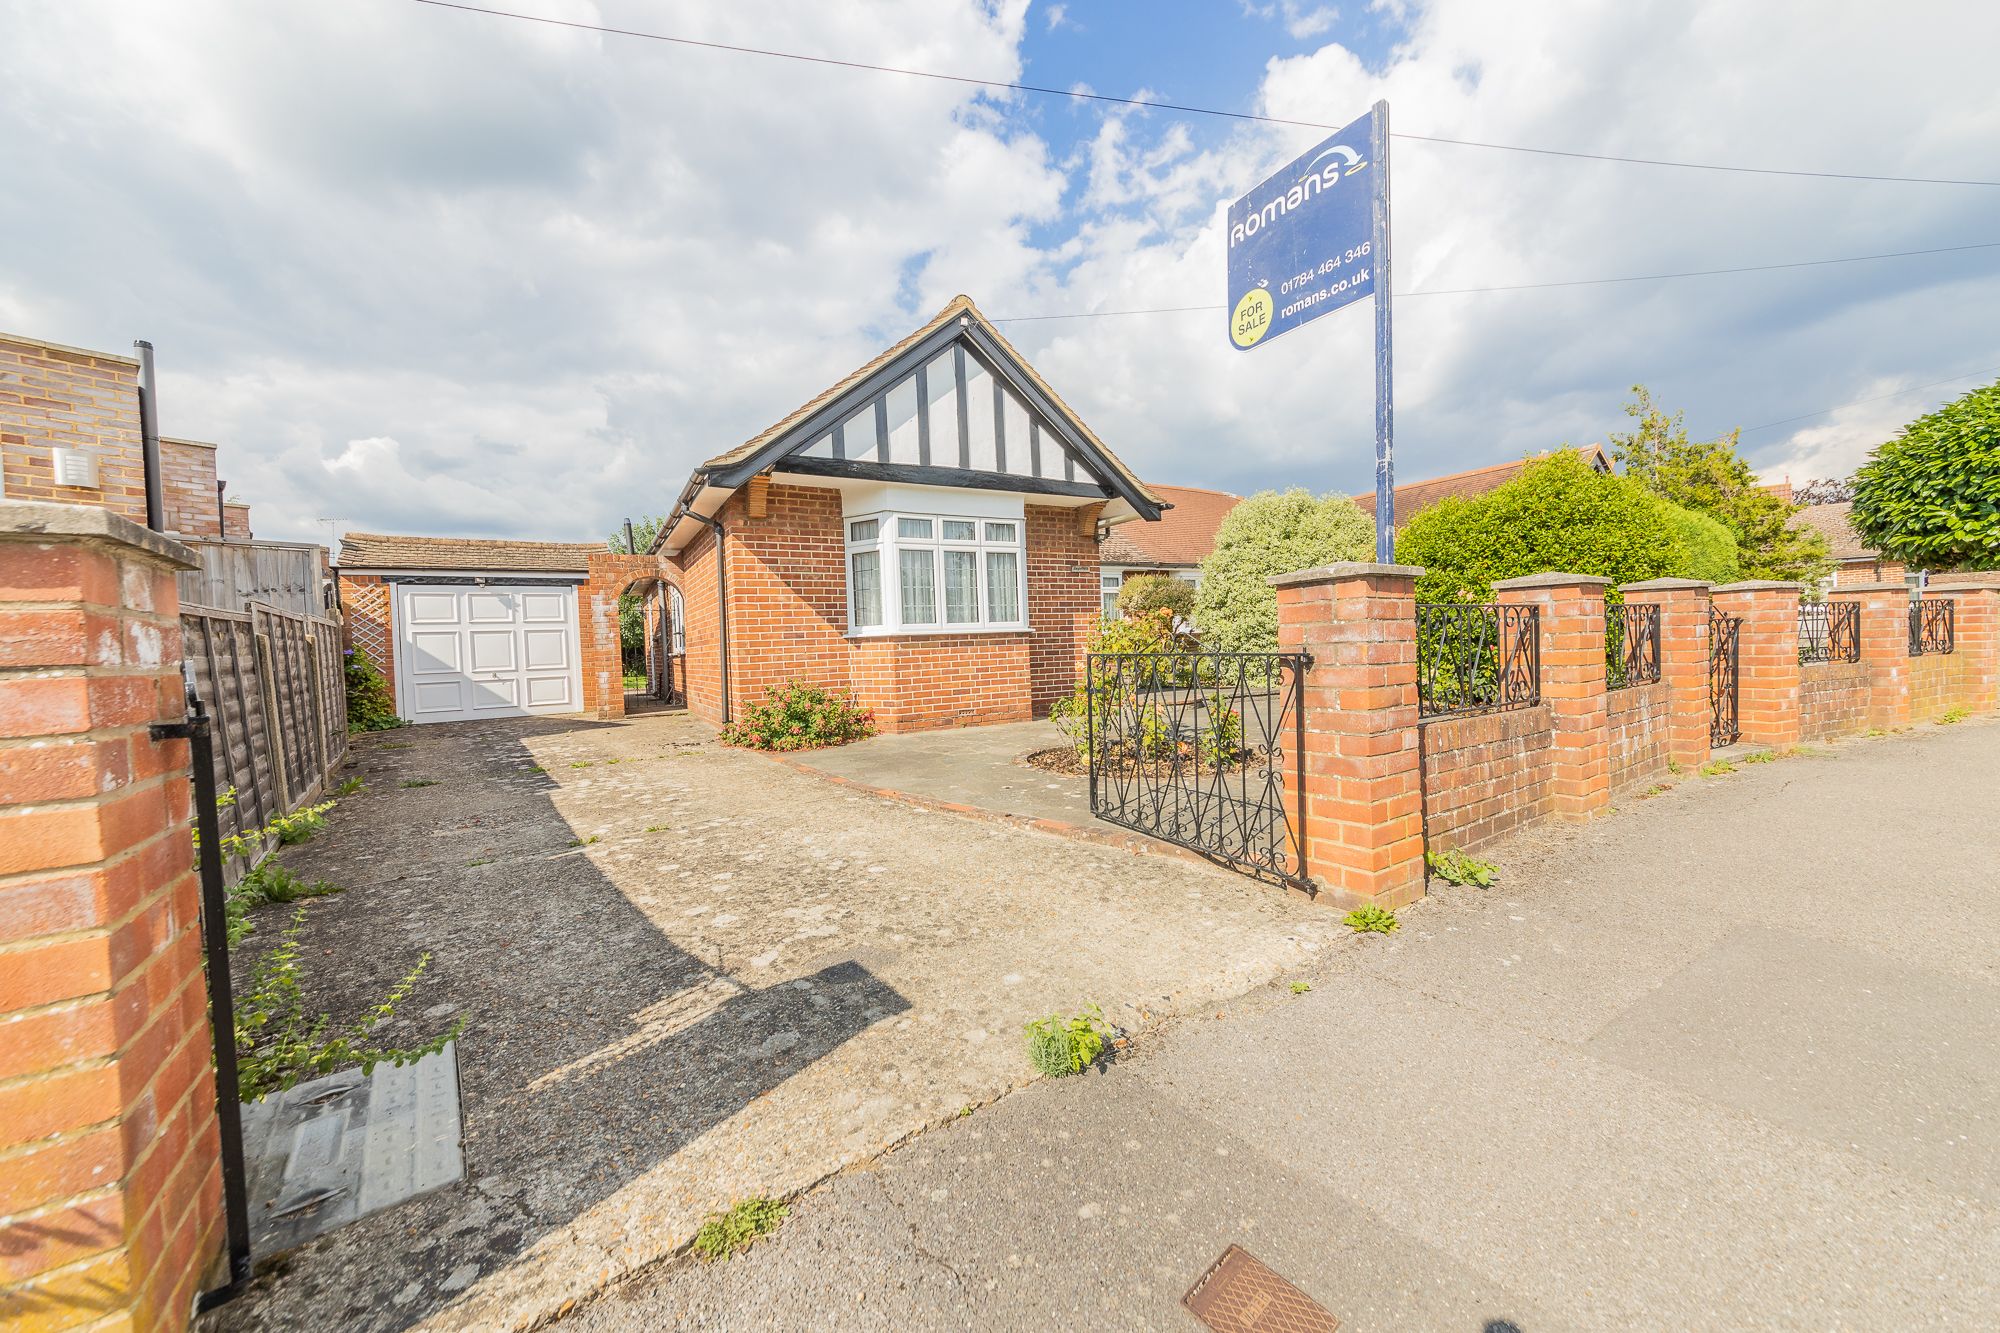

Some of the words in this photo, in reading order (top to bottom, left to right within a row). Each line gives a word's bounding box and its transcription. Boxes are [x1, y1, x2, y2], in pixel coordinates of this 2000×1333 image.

[1281, 268, 1314, 295] 01784
[1318, 255, 1341, 275] 464
[1344, 241, 1371, 263] 346
[1240, 301, 1263, 321] FOR
[1281, 268, 1370, 318] romans.co.uk
[1238, 312, 1266, 336] SALE
